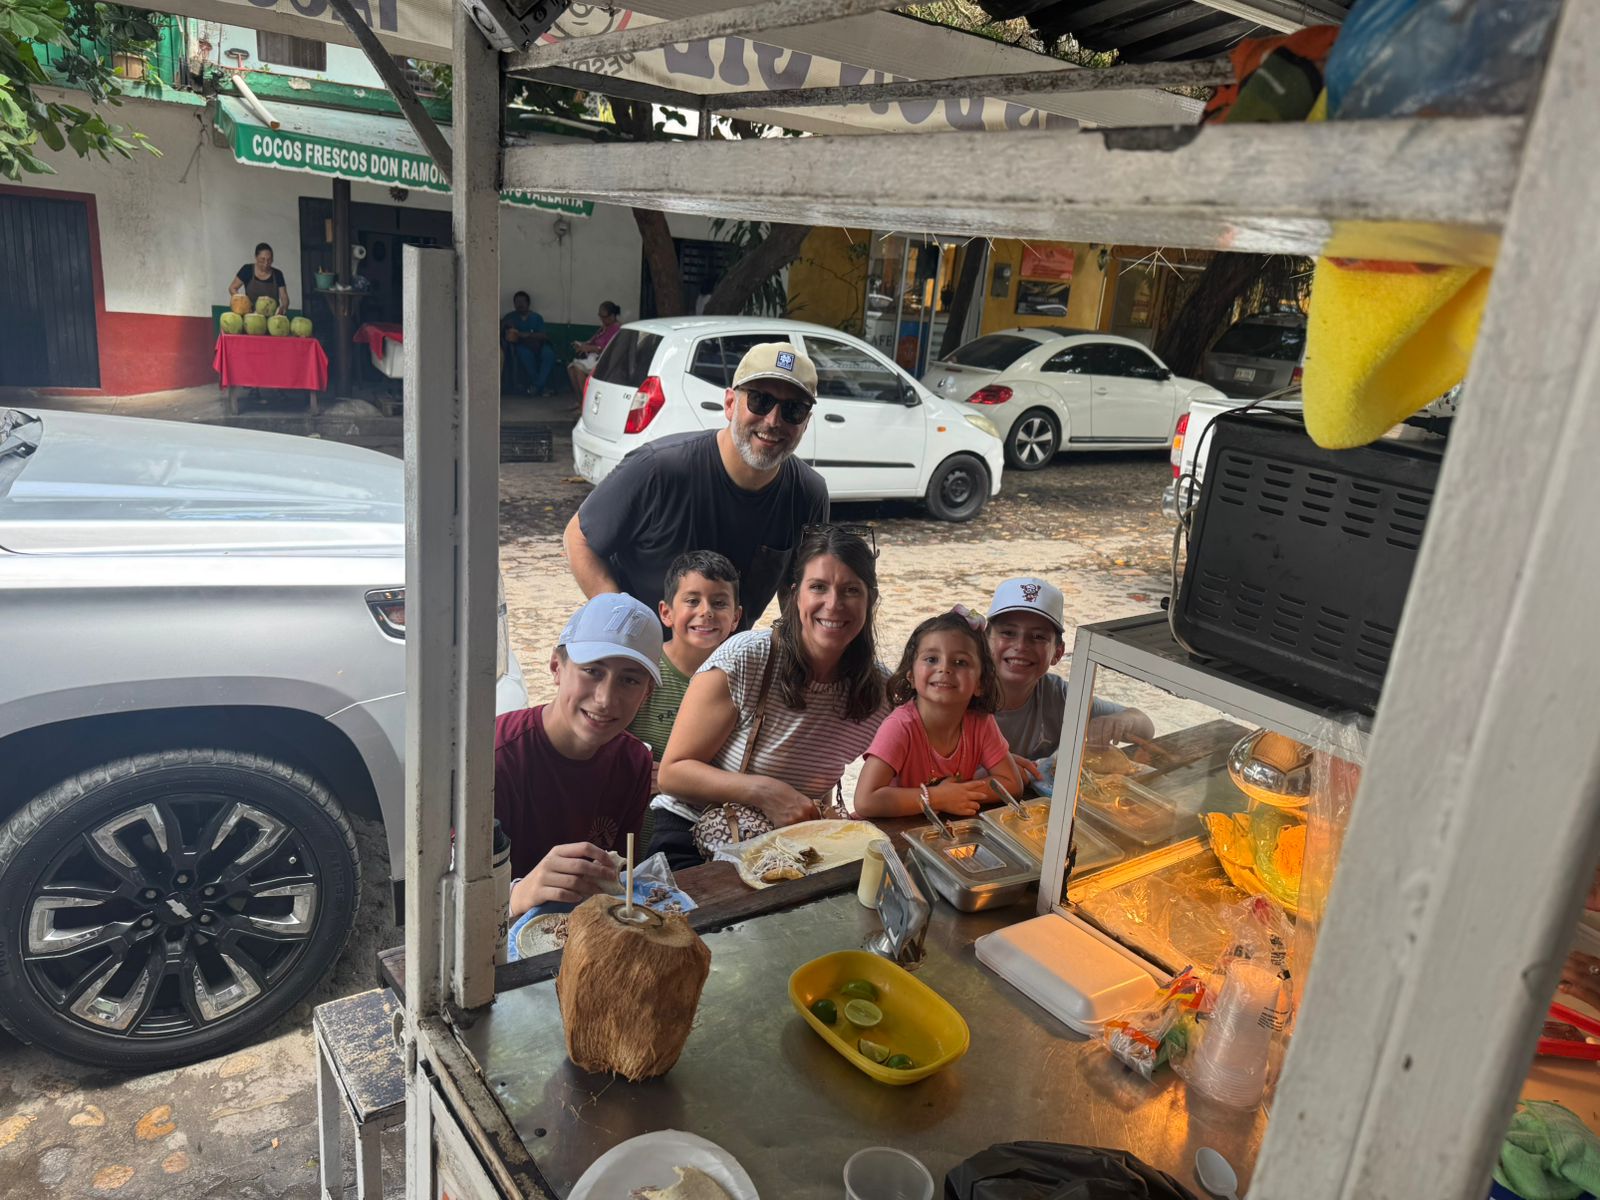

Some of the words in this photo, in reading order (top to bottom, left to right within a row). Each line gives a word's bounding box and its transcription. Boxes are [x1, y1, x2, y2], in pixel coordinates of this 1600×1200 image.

[252, 134, 302, 162] COCOS
[305, 143, 368, 172] FRESCOS
[370, 154, 399, 177] DON
